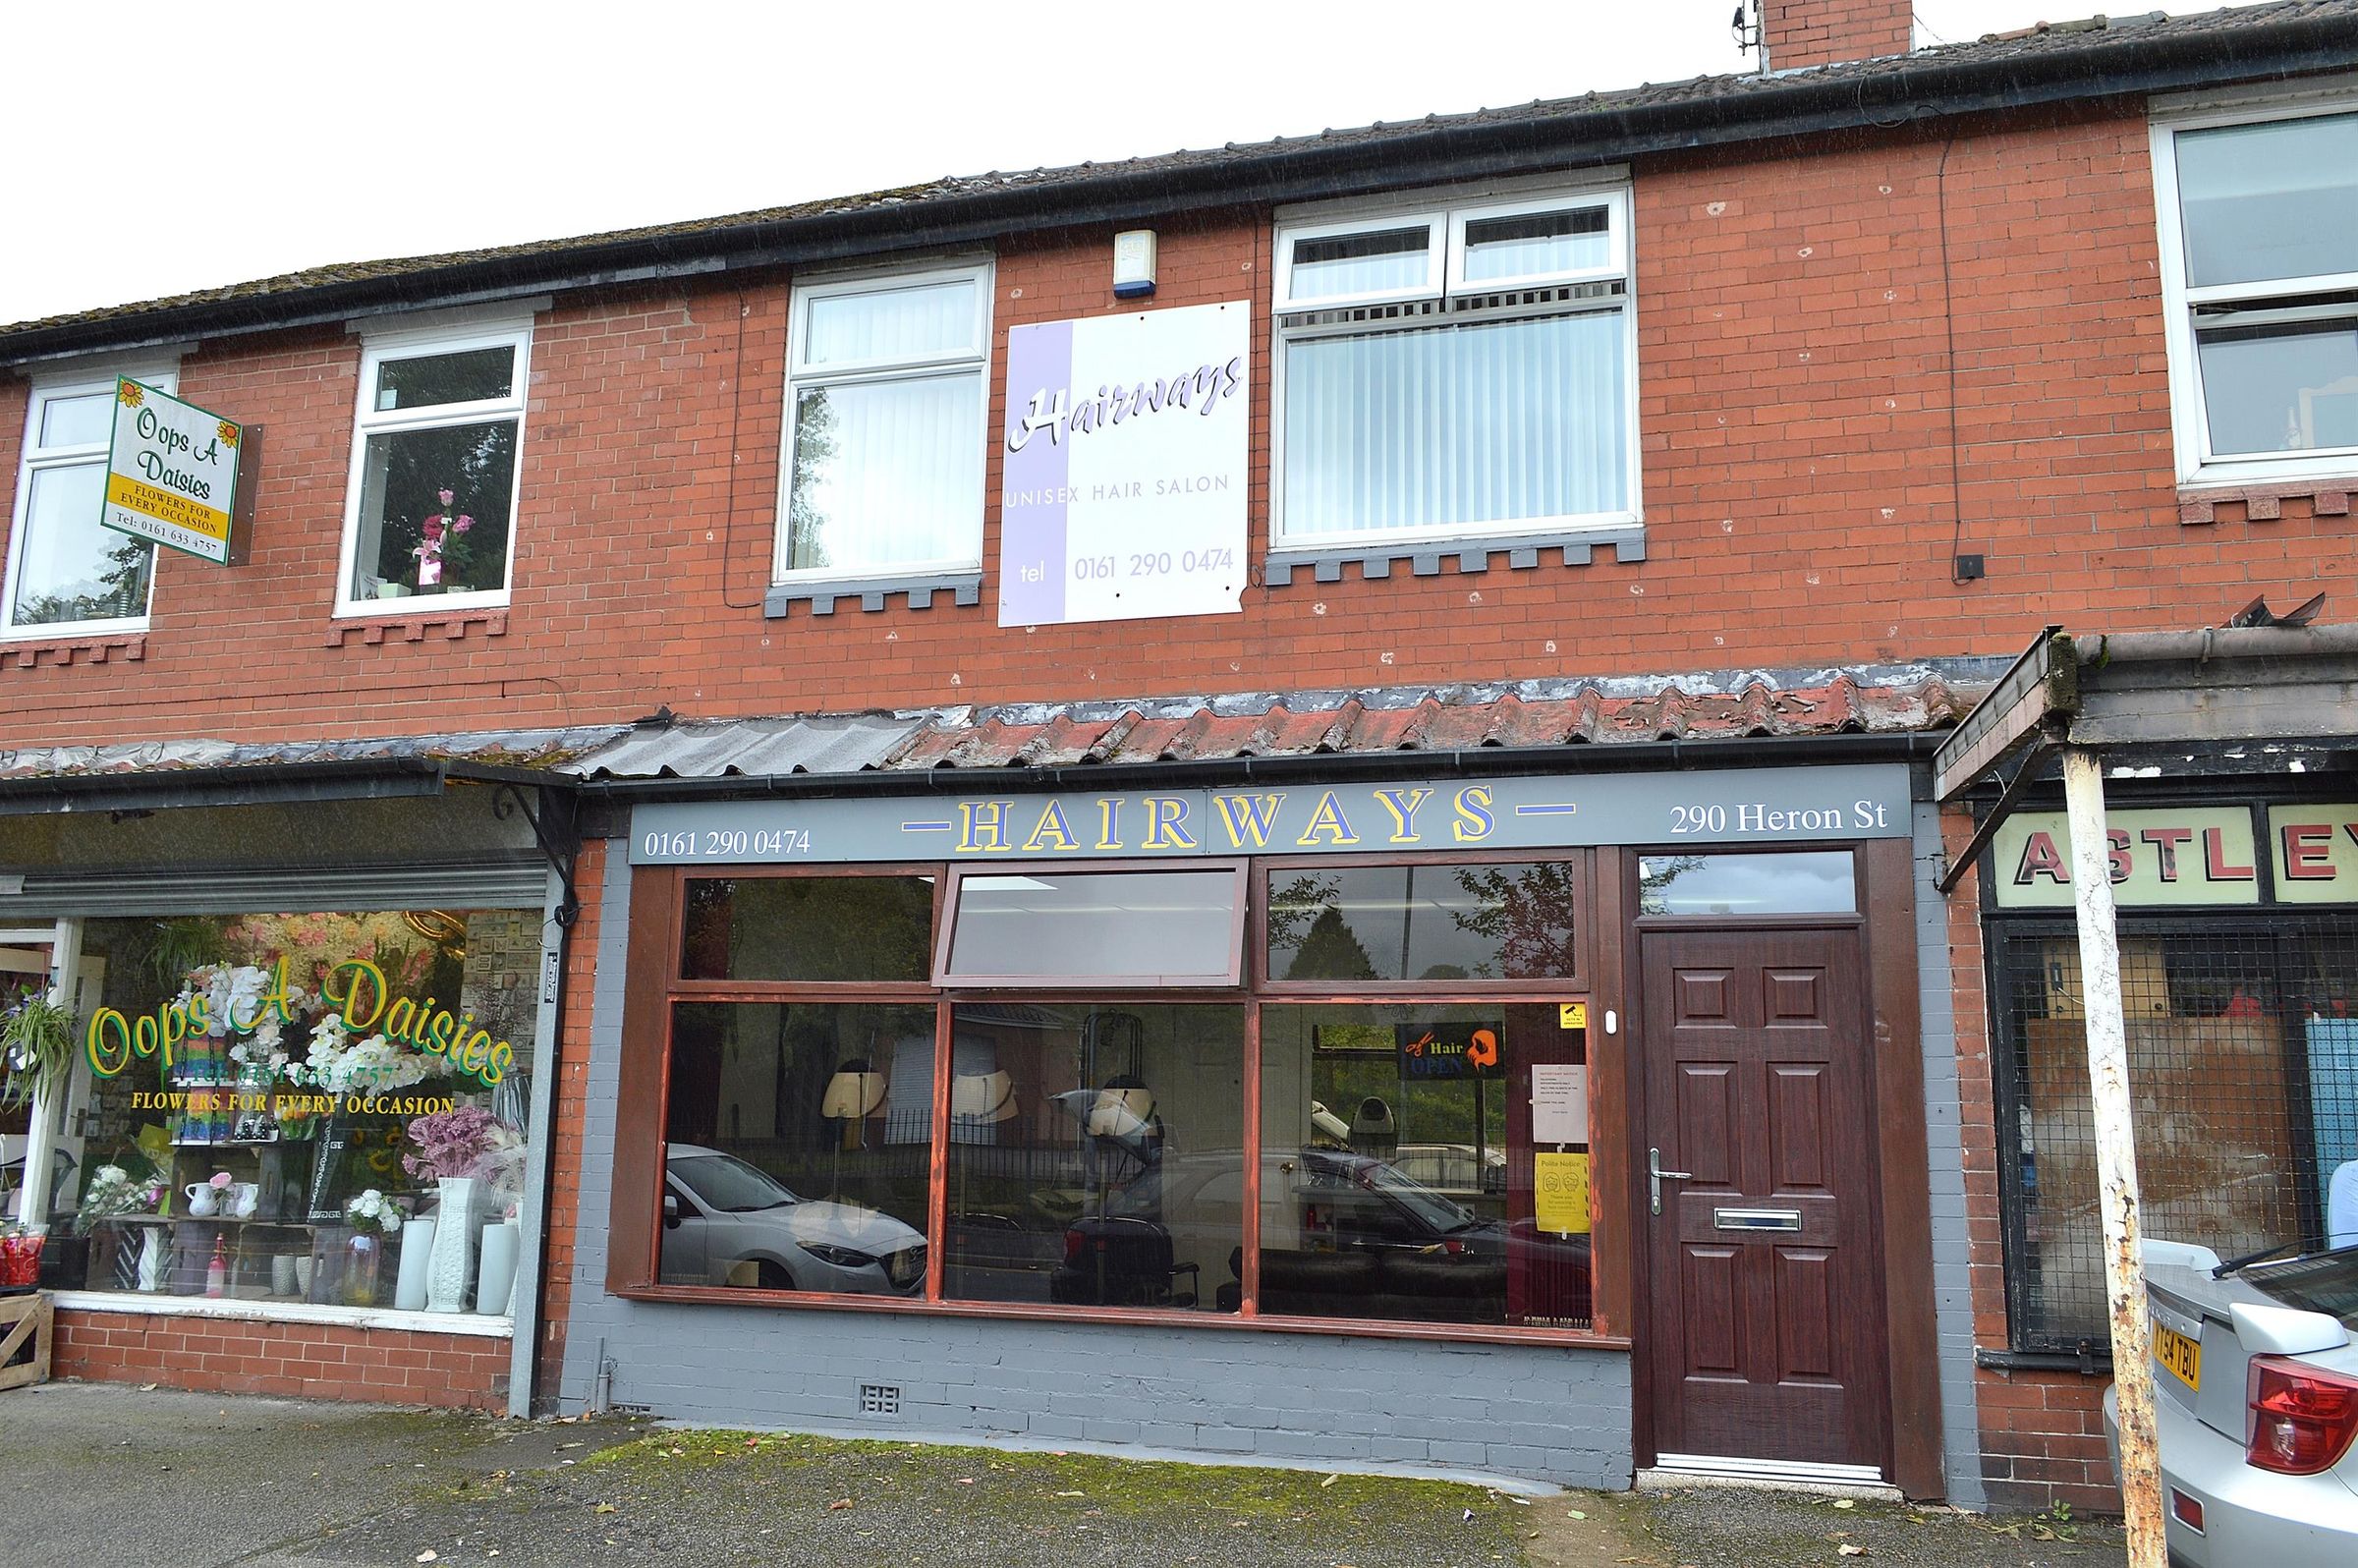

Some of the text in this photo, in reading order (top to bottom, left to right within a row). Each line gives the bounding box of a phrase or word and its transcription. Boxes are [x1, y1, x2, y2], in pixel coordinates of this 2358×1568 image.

[1008, 356, 1243, 453] Hairways
[137, 408, 217, 466] Oops A
[137, 450, 210, 500] Daisies
[1005, 475, 1228, 508] UNISEX HAIR SALON
[121, 492, 217, 533] EVERY OCCASION
[135, 484, 211, 519] FLOWERS FOR
[116, 512, 217, 554] Tel: 0161 633 4757
[1020, 548, 1234, 583] tel 0161 290 0474
[955, 784, 1494, 853] HAIRWAYS
[1669, 800, 1888, 834] 290 Heron St
[644, 829, 811, 857] 0161 290 0474
[2013, 822, 2358, 885] ASTLE
[84, 991, 210, 1080] Oops
[228, 955, 295, 1033] A
[319, 958, 513, 1088] Daisies
[1431, 1042, 1464, 1054] Hair
[238, 1064, 284, 1085] 0161
[296, 1065, 331, 1085] 633
[343, 1064, 394, 1085] 4757
[131, 1092, 456, 1116] FLOWERS FOR EVERY OCCASION
[2177, 1337, 2196, 1381] TBU
